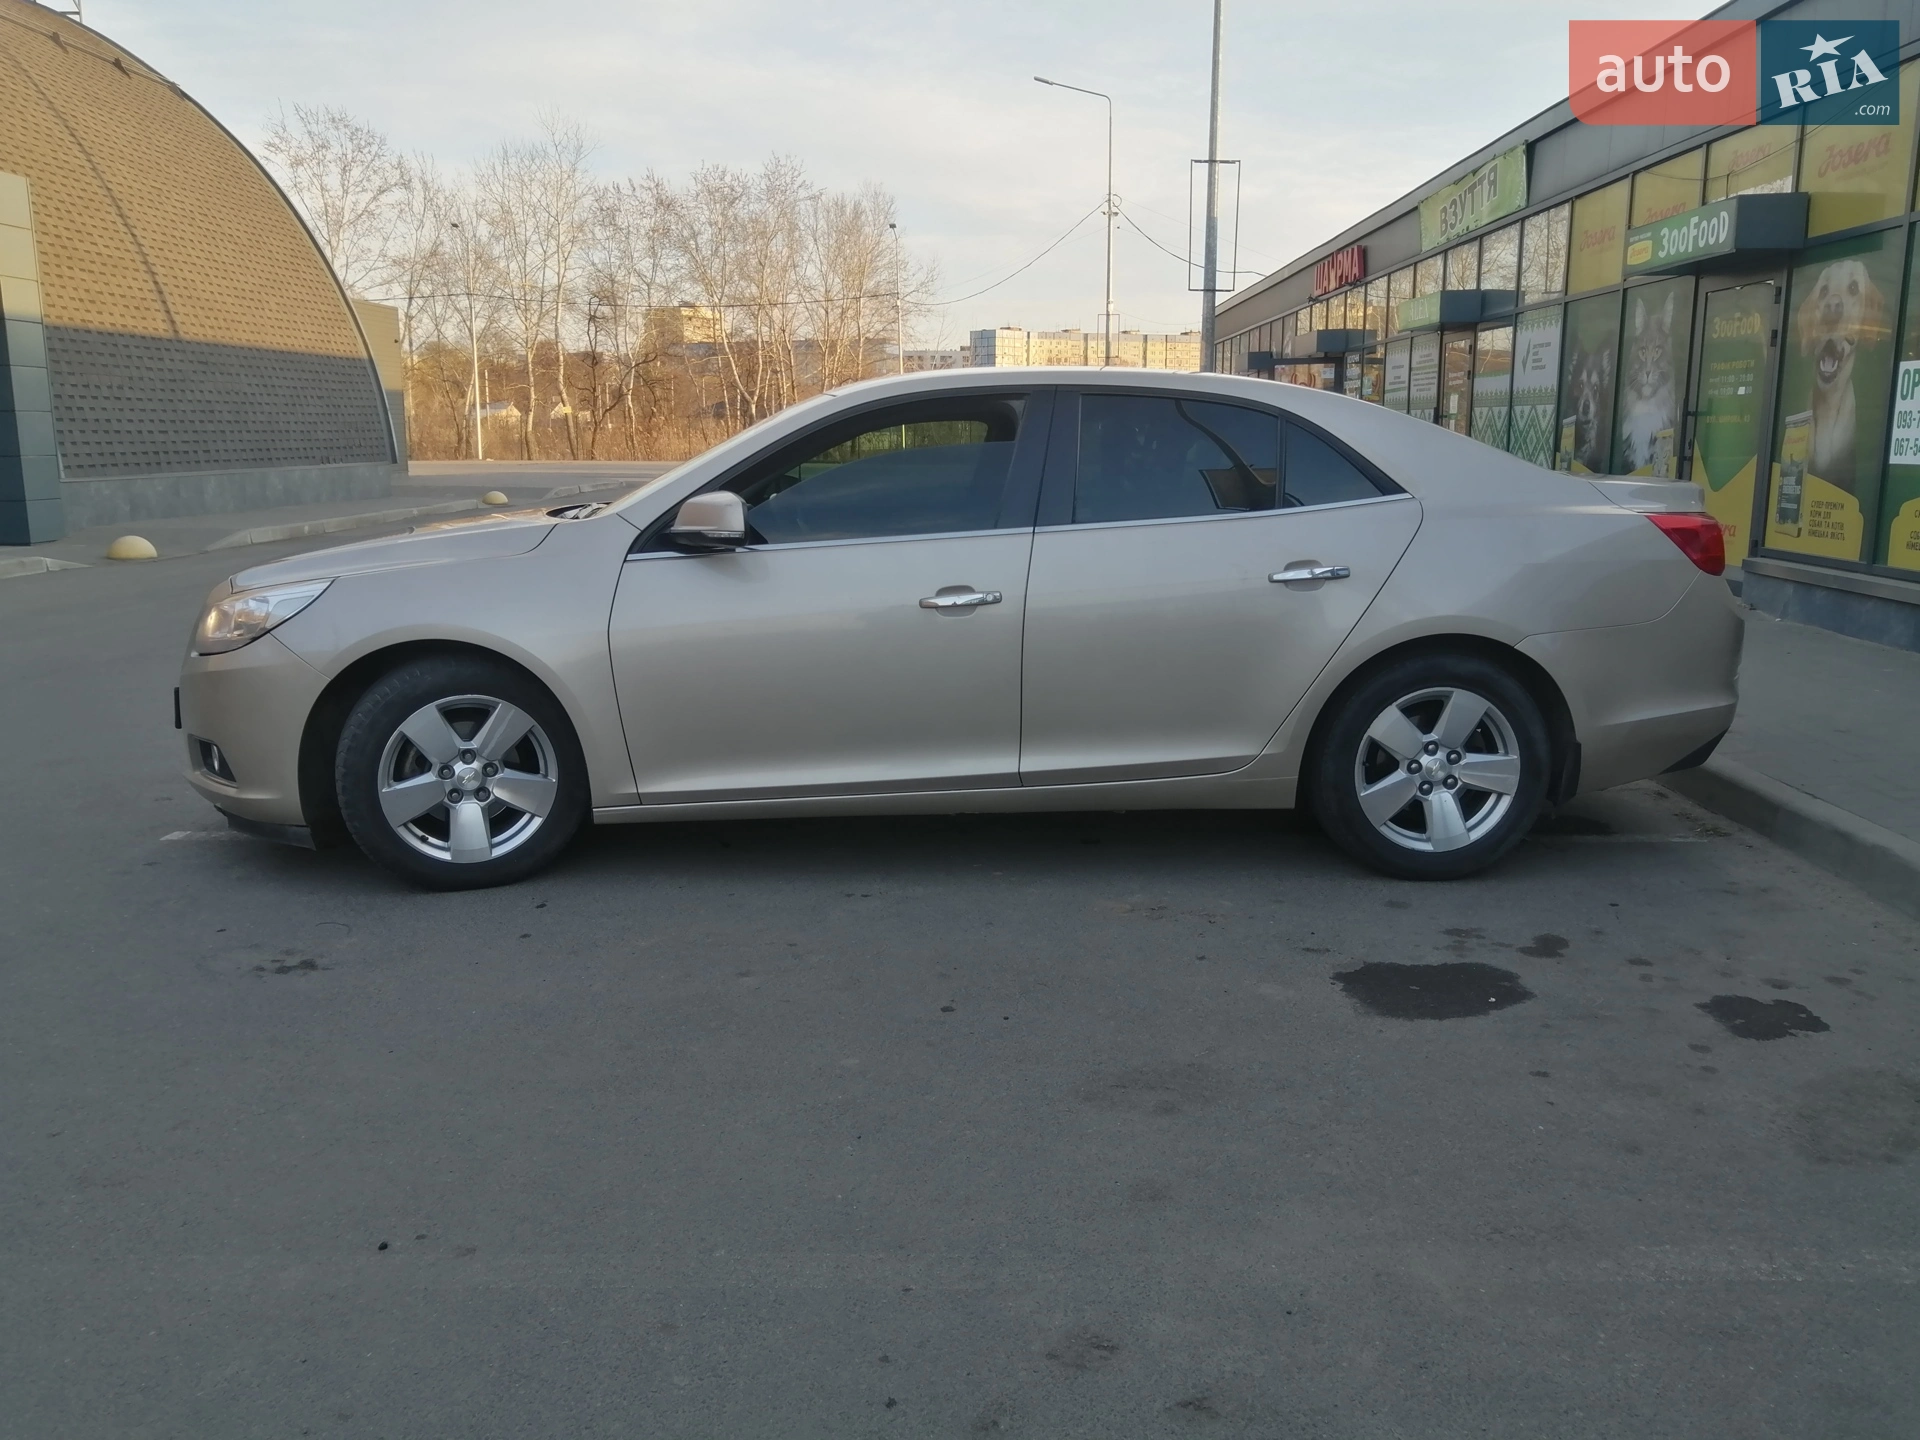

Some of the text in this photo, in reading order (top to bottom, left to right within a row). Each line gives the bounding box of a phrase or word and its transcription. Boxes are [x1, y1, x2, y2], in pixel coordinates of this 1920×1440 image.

[1728, 142, 1772, 173] Josera
[1818, 132, 1892, 178] Josera
[1439, 162, 1499, 240] ВЗУТТЯ
[1580, 225, 1616, 252] Josera
[1314, 245, 1361, 297] ШАУРМА
[1809, 519, 1844, 530] СОБАК ТА КОТІВ
[1810, 510, 1831, 519] КОРМ ДЛЯ
[1830, 531, 1845, 541] ЯКІСТЬ
